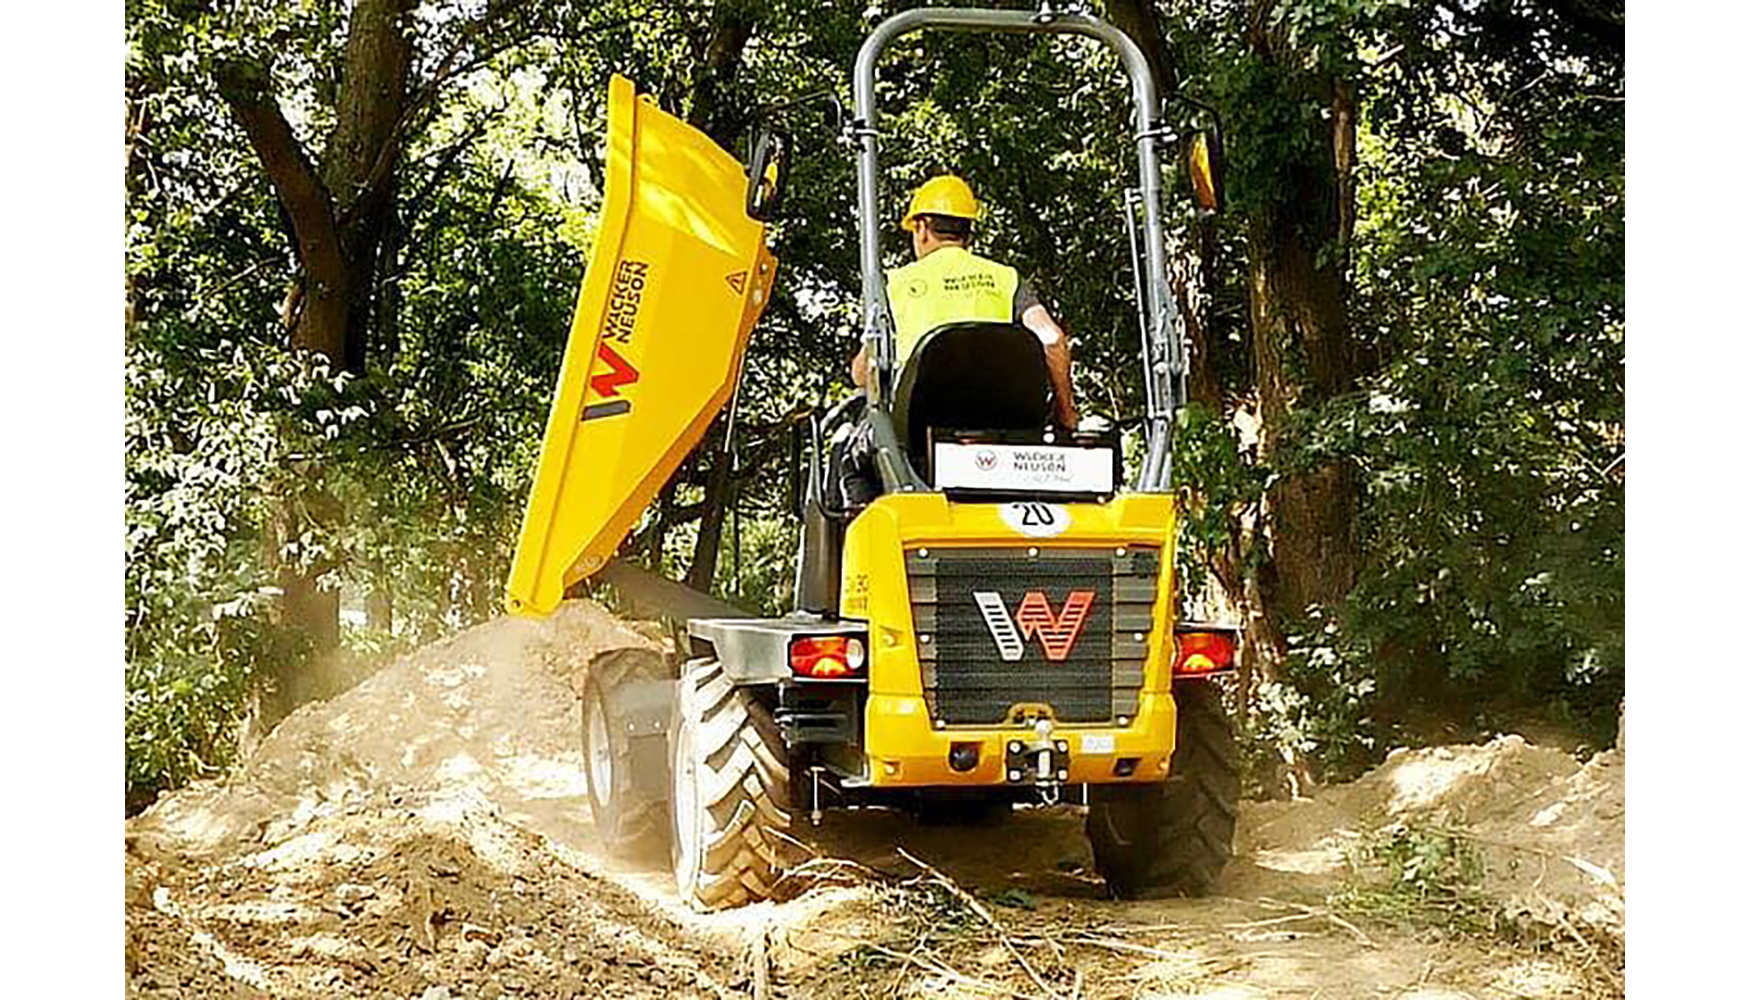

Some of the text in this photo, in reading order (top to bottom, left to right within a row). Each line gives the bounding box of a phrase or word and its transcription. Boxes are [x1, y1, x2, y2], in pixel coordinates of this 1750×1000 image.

[602, 259, 634, 340] WACKER
[616, 261, 649, 344] NEUSON
[1012, 504, 1055, 526] 20
